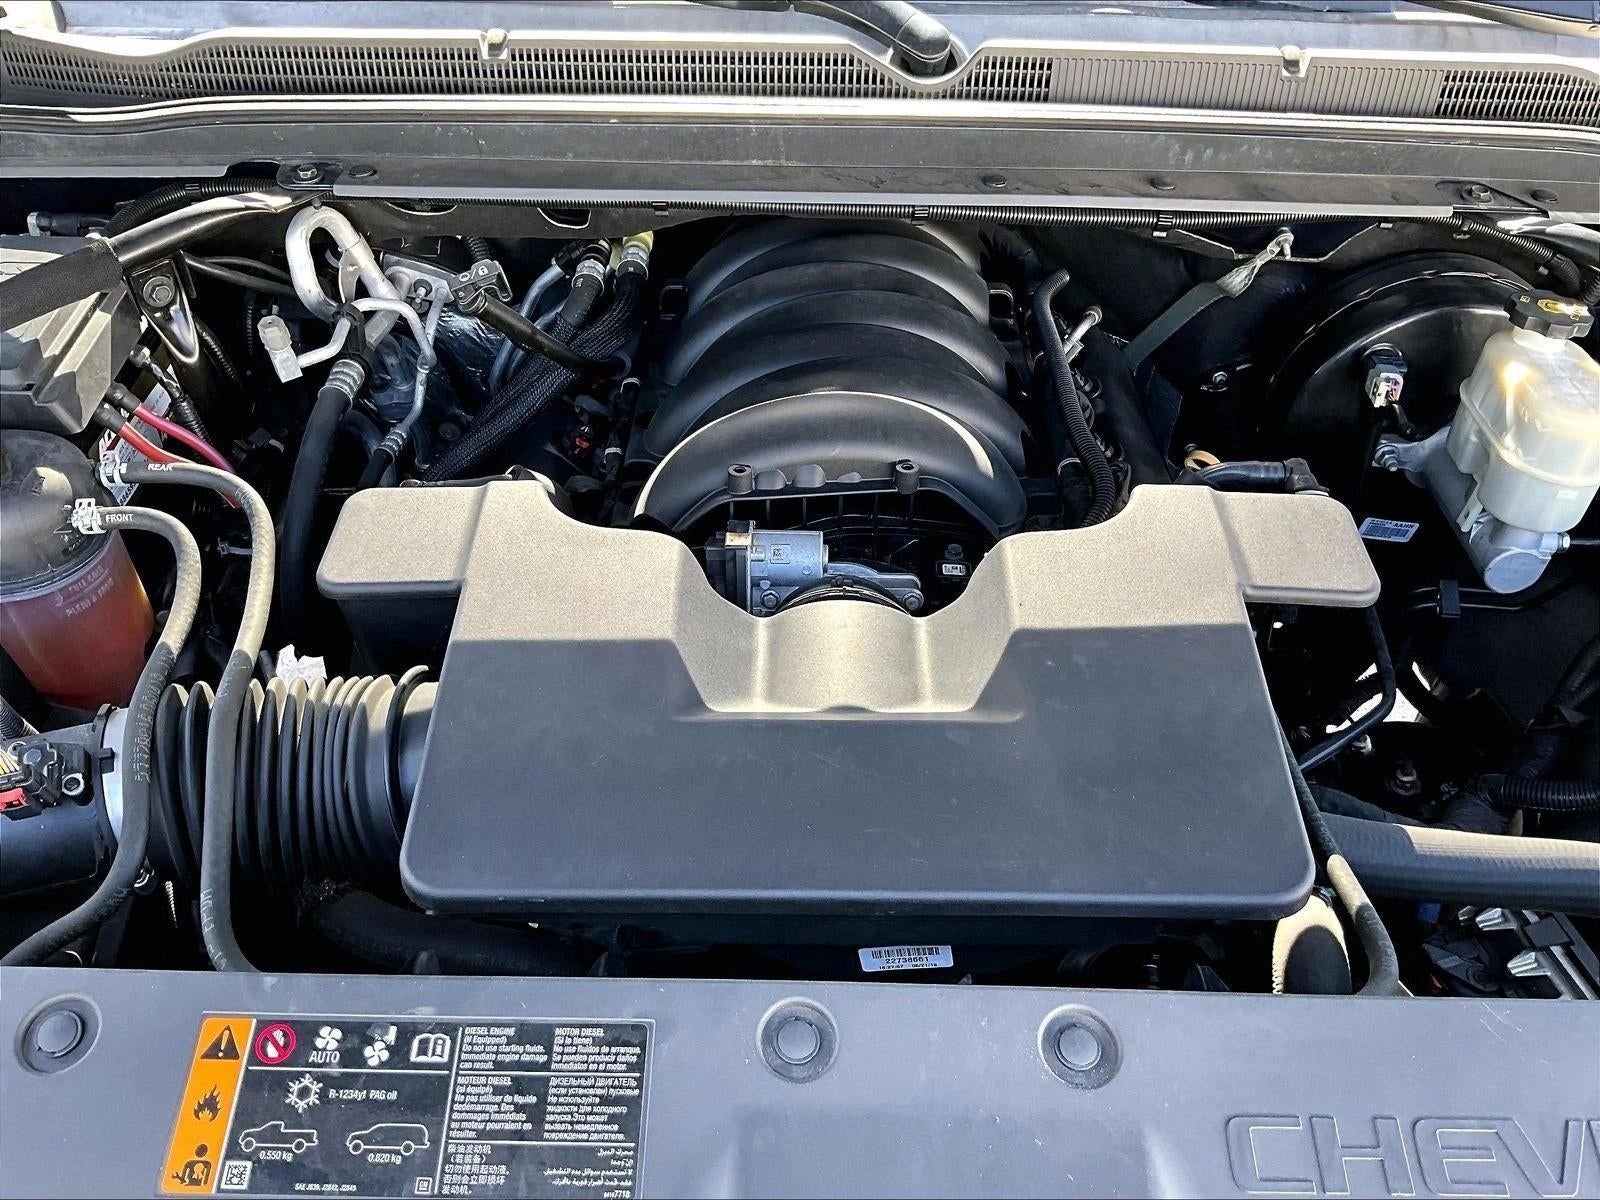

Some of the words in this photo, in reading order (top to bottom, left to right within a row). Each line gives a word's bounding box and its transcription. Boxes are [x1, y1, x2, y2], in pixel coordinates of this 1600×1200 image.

[147, 463, 173, 472] REAR
[105, 513, 134, 523] FRONT
[465, 1026, 489, 1035] DIESEL
[489, 1027, 516, 1036] ENGINE
[555, 1027, 580, 1036] MOTOR
[580, 1027, 604, 1036] DIESEL
[473, 1035, 507, 1045] Equipped)
[573, 1036, 593, 1045] tiene)
[462, 1044, 472, 1052] Do
[473, 1044, 484, 1052] not
[498, 1044, 524, 1053] starting
[525, 1044, 545, 1053] fluids.
[553, 1045, 563, 1053] No
[577, 1045, 600, 1053] fluidos
[600, 1045, 610, 1053] de
[610, 1046, 641, 1055] arranque.
[308, 1050, 340, 1063] AUTO
[461, 1052, 496, 1061] Immediate
[497, 1053, 520, 1062] engine
[520, 1053, 548, 1063] damage
[552, 1053, 562, 1061] Se
[562, 1054, 587, 1063] pueden
[588, 1054, 616, 1063] producir
[473, 1061, 495, 1069] result.
[551, 1062, 588, 1071] inmediatos
[598, 1062, 606, 1070] el
[606, 1063, 627, 1071] motor.
[457, 1076, 487, 1085] MOTEUR
[487, 1076, 512, 1085] DIESEL
[549, 1076, 595, 1086] ДИЗЕЛЬНЫЙ
[595, 1077, 638, 1087] ДВИГАТЕЛЬ
[466, 1085, 493, 1094] équipé)
[329, 1089, 366, 1101] R-1234yf
[369, 1089, 386, 1100] PAG
[387, 1090, 398, 1100] oil
[454, 1094, 465, 1102] Ne
[465, 1095, 478, 1103] pas
[479, 1094, 503, 1103] utiliser
[503, 1094, 513, 1102] de
[513, 1094, 538, 1104] liquide
[500, 1103, 515, 1111] Des
[579, 1105, 592, 1113] для
[452, 1112, 490, 1121] dommages
[490, 1112, 527, 1121] immédiats
[586, 1114, 608, 1122] может
[460, 1121, 486, 1129] moteur
[486, 1121, 522, 1131] pourraient
[522, 1122, 533, 1130] en
[449, 1129, 477, 1138] résulter.
[447, 1144, 492, 1154] 柴油发动机
[259, 1150, 281, 1160] 0.550
[282, 1151, 293, 1162] kg
[367, 1153, 390, 1163] 0.820
[391, 1153, 402, 1164] kg
[294, 1183, 306, 1191] SAE
